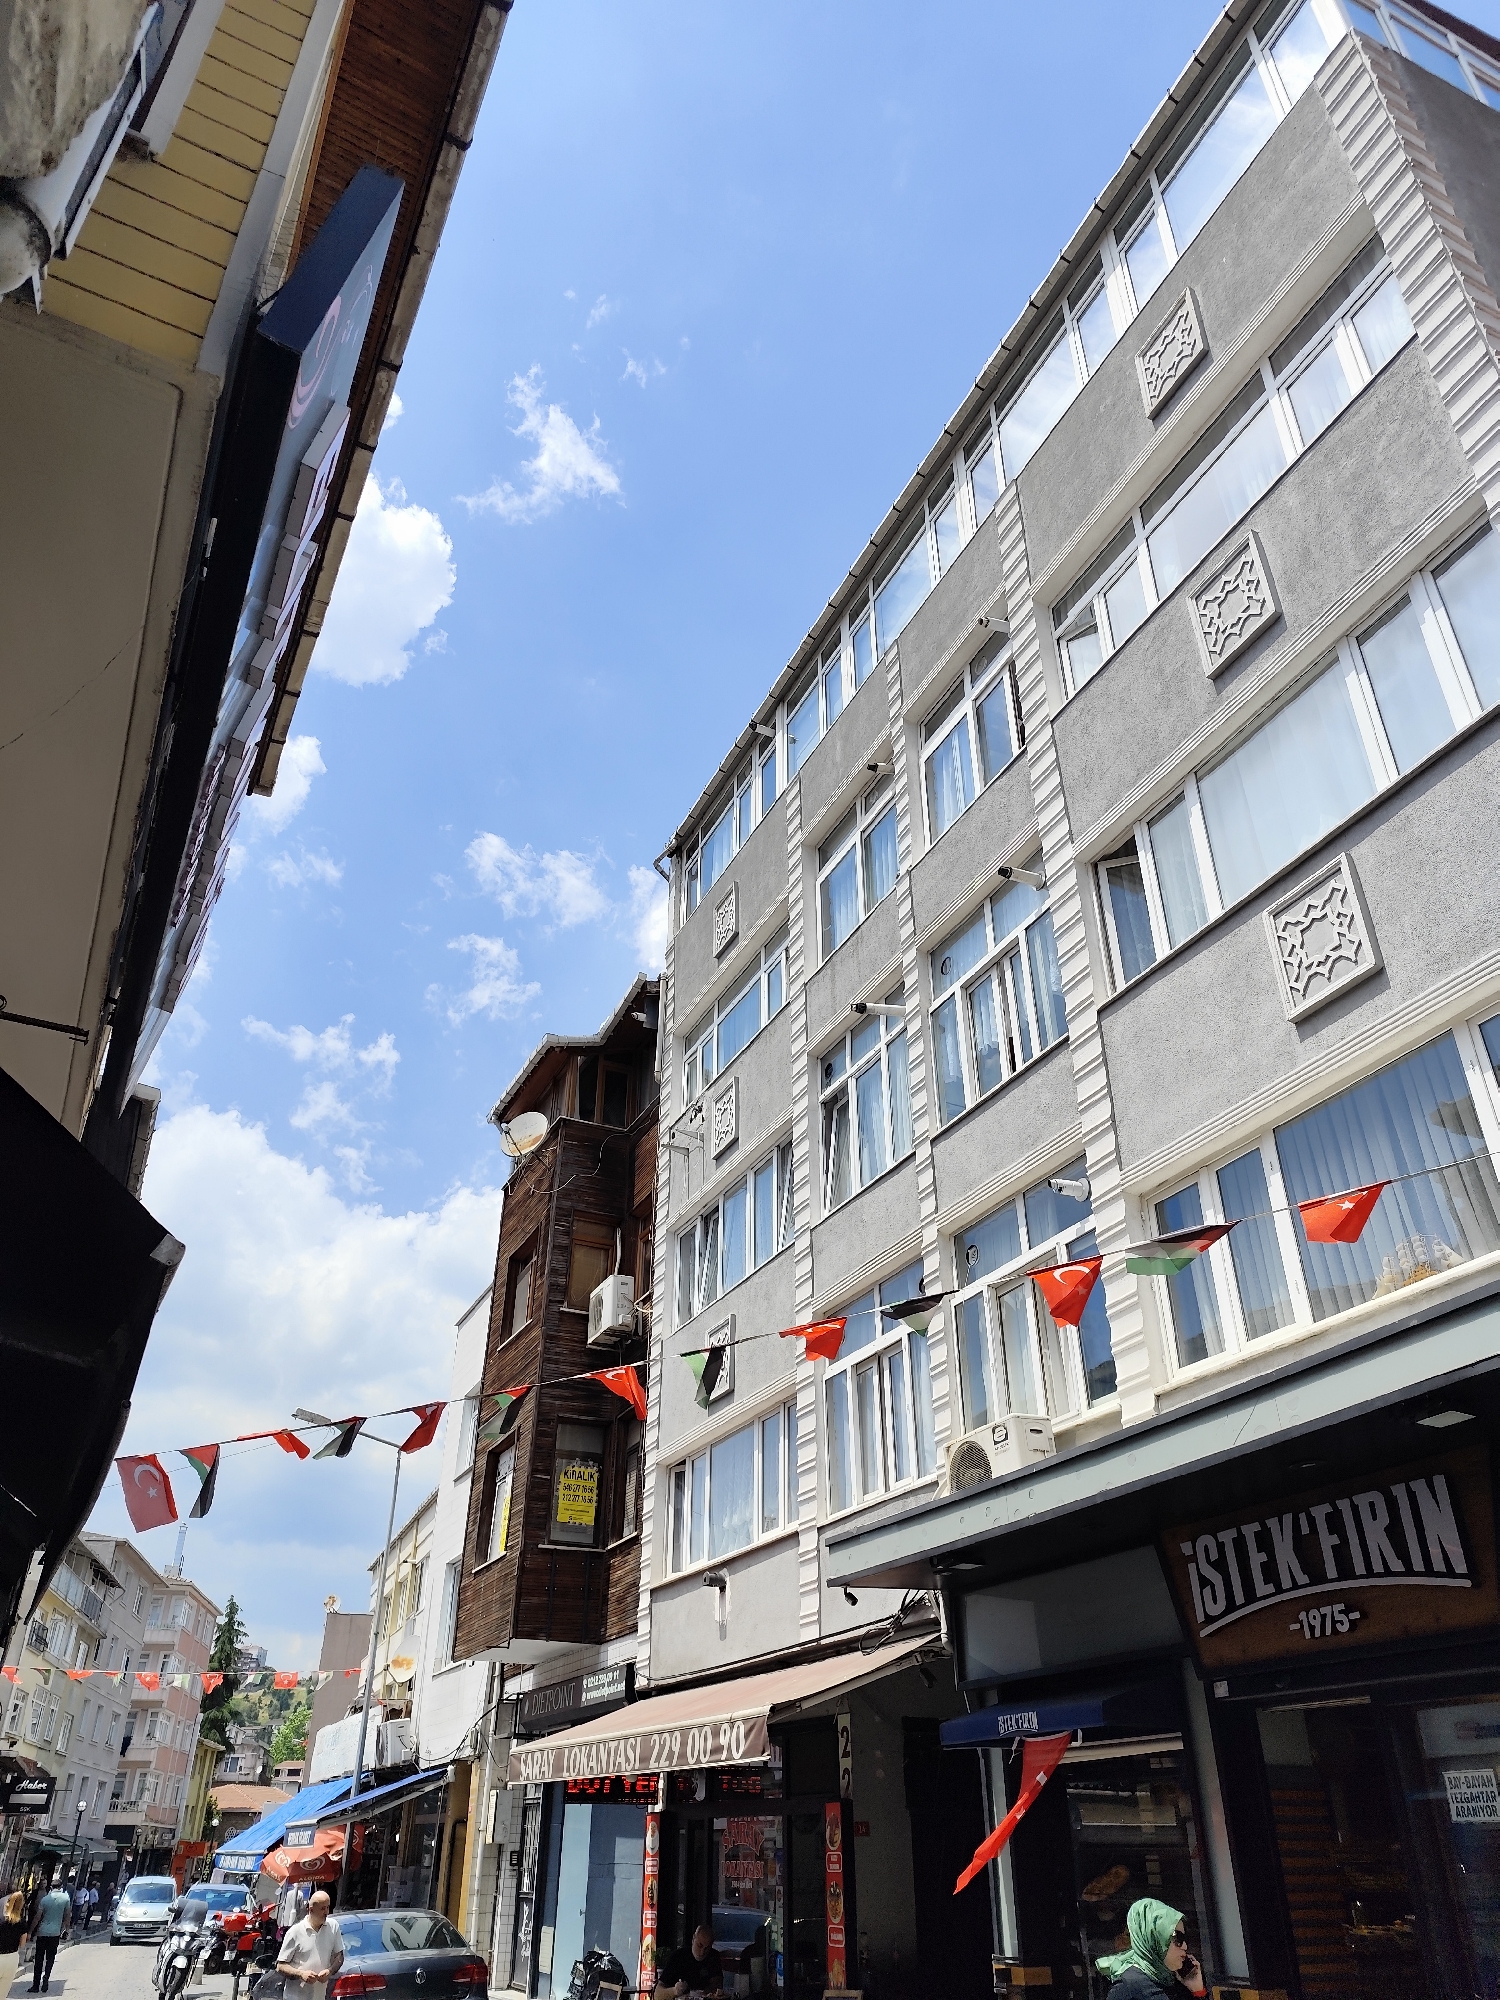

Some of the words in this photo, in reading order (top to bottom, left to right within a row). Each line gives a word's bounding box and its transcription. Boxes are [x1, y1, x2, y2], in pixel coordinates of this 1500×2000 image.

[519, 1749, 556, 1782] SARAY
[562, 1736, 643, 1778] LOKANTASI
[649, 1730, 682, 1769] 229
[686, 1725, 713, 1765] 00
[719, 1720, 746, 1761] 90
[1449, 1790, 1498, 1805] TEZGAHTAR
[1455, 1804, 1499, 1819] ARANIYOR
